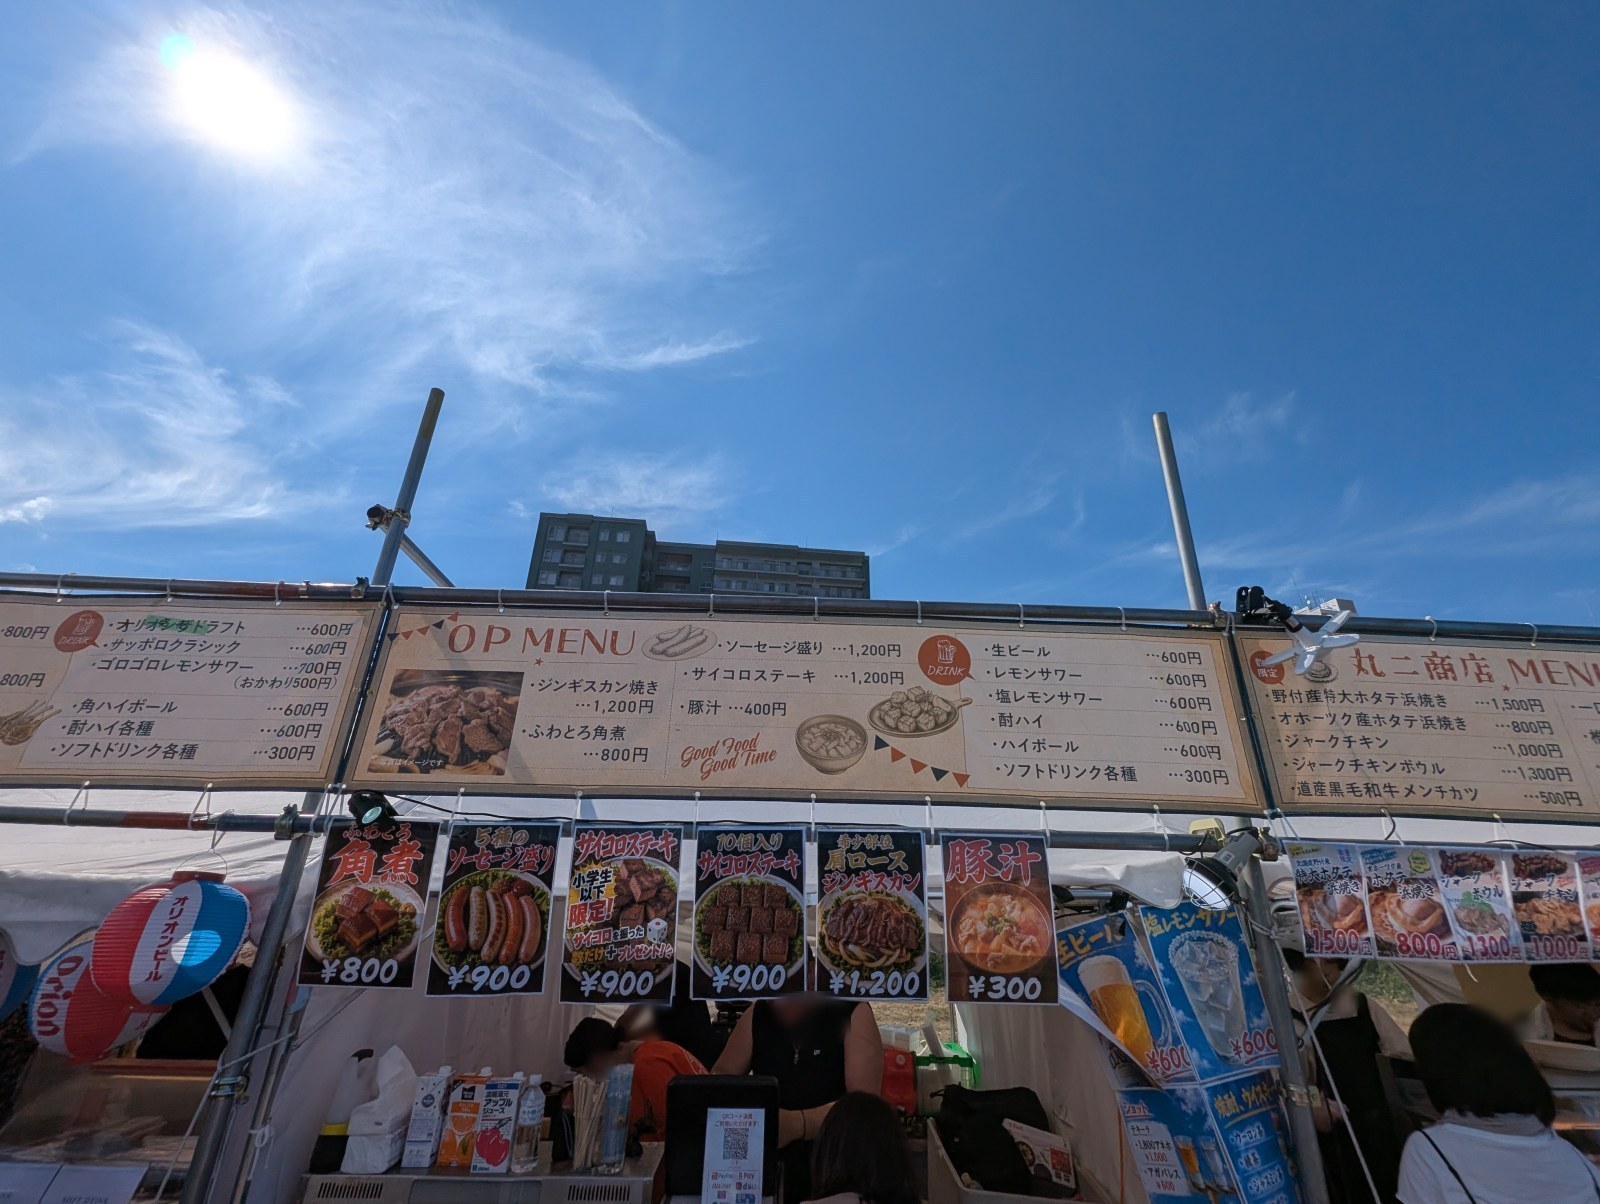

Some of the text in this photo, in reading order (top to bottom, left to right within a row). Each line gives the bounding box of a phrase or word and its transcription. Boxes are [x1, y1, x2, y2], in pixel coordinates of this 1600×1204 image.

[110, 637, 240, 654] サッポロクラシック
[448, 624, 637, 656] OP MENU
[726, 640, 823, 655] ソーセージ盛り
[991, 643, 1051, 658] 生ビール
[97, 657, 254, 674] ゴロゴロレモンサワー
[691, 667, 816, 684] サイコロステーキ
[927, 664, 966, 677] DRINK
[994, 666, 1082, 682] レモンサワー
[1349, 648, 1495, 684] 丸二商店
[537, 678, 659, 695] ジンギスカン焼き
[80, 699, 178, 714] 角ハイボール
[995, 688, 1103, 706] 塩レモンサワー
[1272, 689, 1447, 708] 野付産特大ホタテ浜焼き
[687, 700, 722, 716] 豚汁
[66, 720, 155, 737] 酎ハイ各種
[998, 712, 1043, 729] 酎ハイ
[1278, 711, 1467, 731] オホーツク産ホタテ浜焼き
[528, 724, 626, 742] ふわとろ角煮
[1284, 733, 1388, 750] ジャークチキン
[57, 743, 199, 760] ソフトドリンク各種
[680, 742, 719, 768] Good
[1000, 738, 1080, 754] ハイボール
[700, 757, 738, 781] Good
[1003, 763, 1138, 783] ソフトドリンク各種
[1291, 756, 1445, 775] ジャークチキンボウル
[1297, 780, 1478, 801] 道産黒毛和牛メンチカツ
[575, 829, 678, 865] サイコロステーキ
[325, 838, 424, 887] 角煮
[446, 844, 556, 876] ソーセージ盛り
[698, 849, 802, 880] サイコロステーキ
[824, 849, 909, 872] 肩ロース
[946, 838, 1042, 887] 豚汁
[572, 867, 613, 889] 小学生
[822, 869, 921, 894] ジンギスカン
[579, 886, 605, 902] 以下
[144, 895, 189, 982] オリオンビール
[321, 956, 398, 984] ¥800
[448, 964, 532, 992] ¥900
[712, 964, 787, 994] ¥900
[580, 969, 655, 998] ¥900
[968, 975, 1042, 1000] ¥300
[35, 955, 85, 1037] Orion
